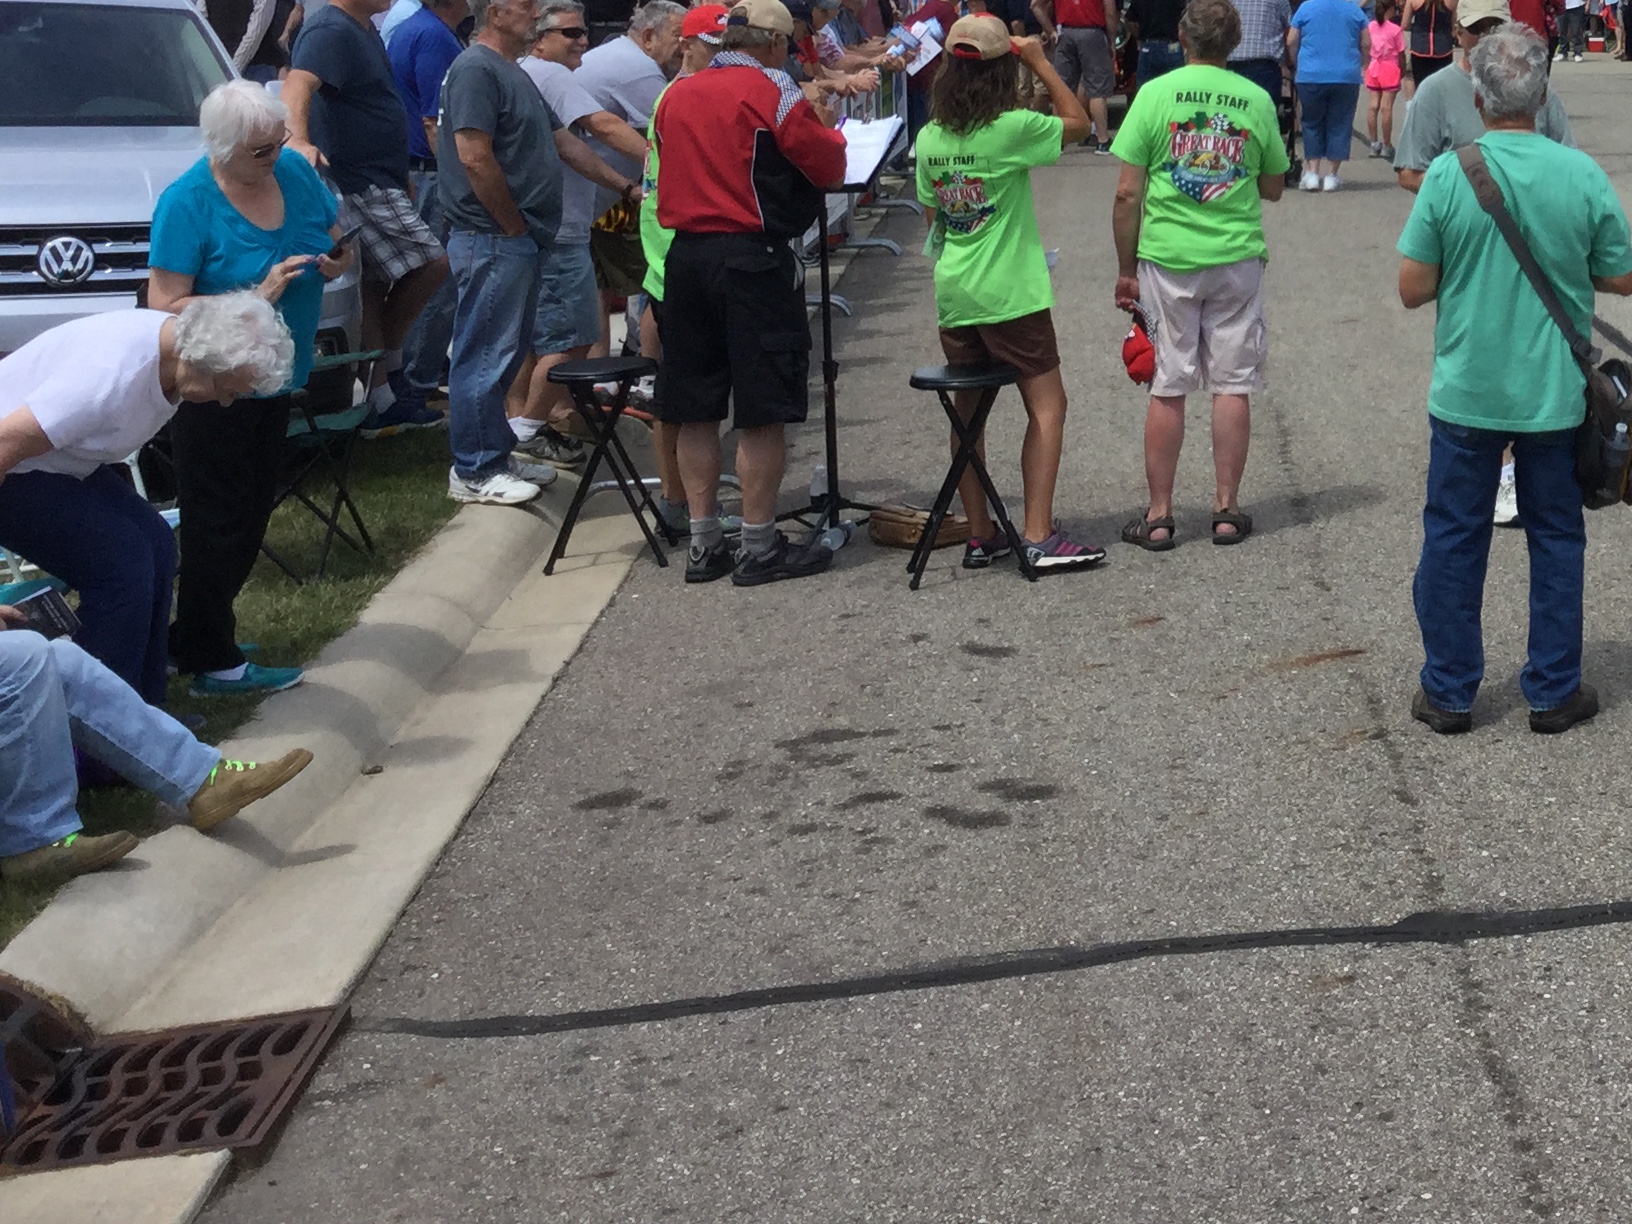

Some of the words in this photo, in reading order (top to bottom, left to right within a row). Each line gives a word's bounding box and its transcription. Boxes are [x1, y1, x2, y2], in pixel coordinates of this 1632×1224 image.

[1175, 91, 1212, 105] RALLY
[1215, 94, 1250, 112] STAFF
[1171, 130, 1214, 160] GREAT
[1212, 136, 1246, 165] RACE
[927, 157, 951, 167] RALLY
[952, 155, 976, 166] STAFF
